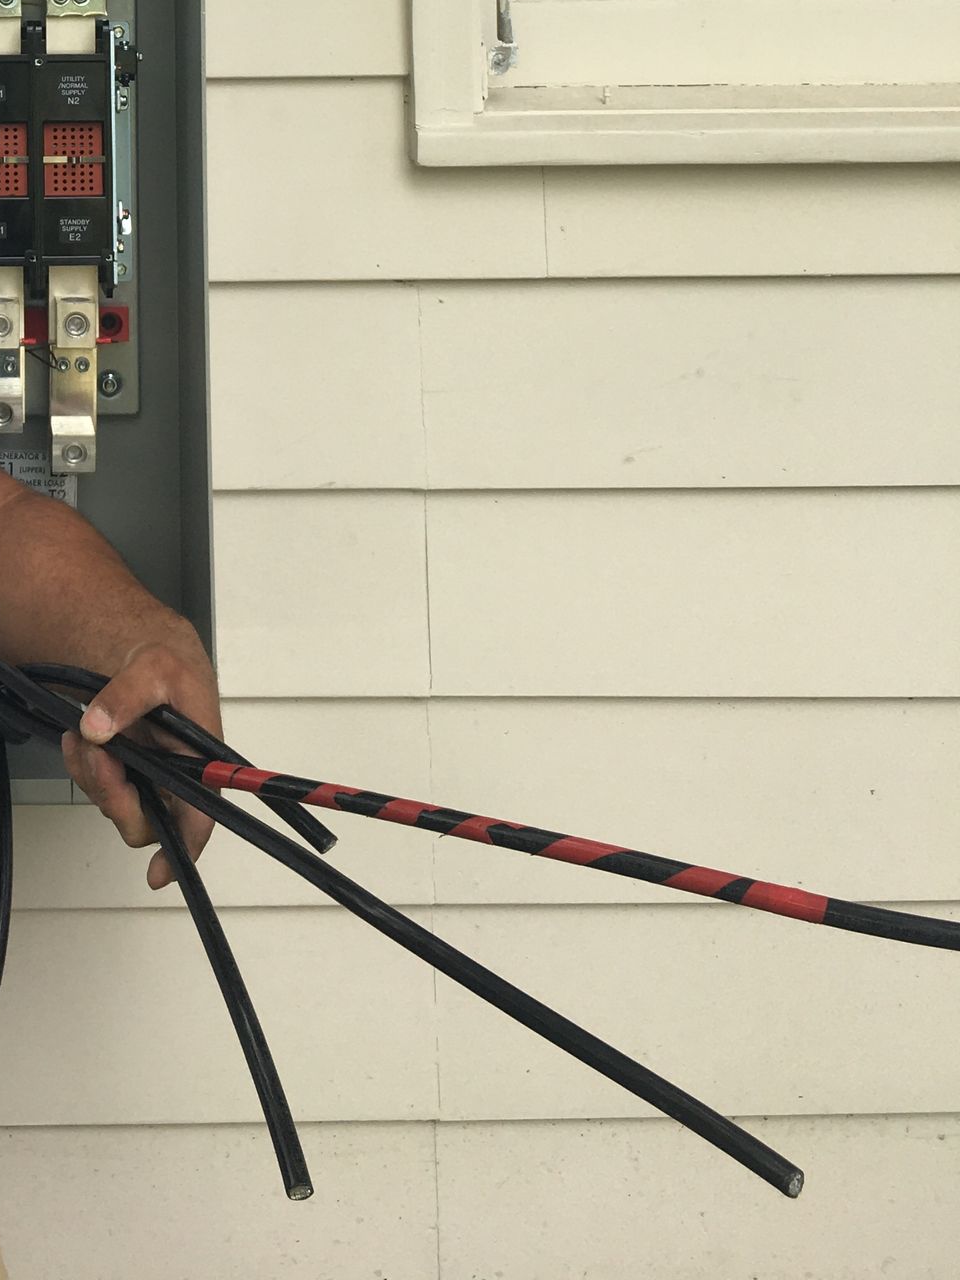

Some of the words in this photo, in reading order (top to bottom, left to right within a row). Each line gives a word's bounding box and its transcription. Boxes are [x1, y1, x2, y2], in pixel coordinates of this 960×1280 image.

[58, 82, 89, 90] /NORMAL
[67, 97, 80, 105] N2
[69, 233, 81, 241] E2
[44, 479, 65, 487] LOAD
